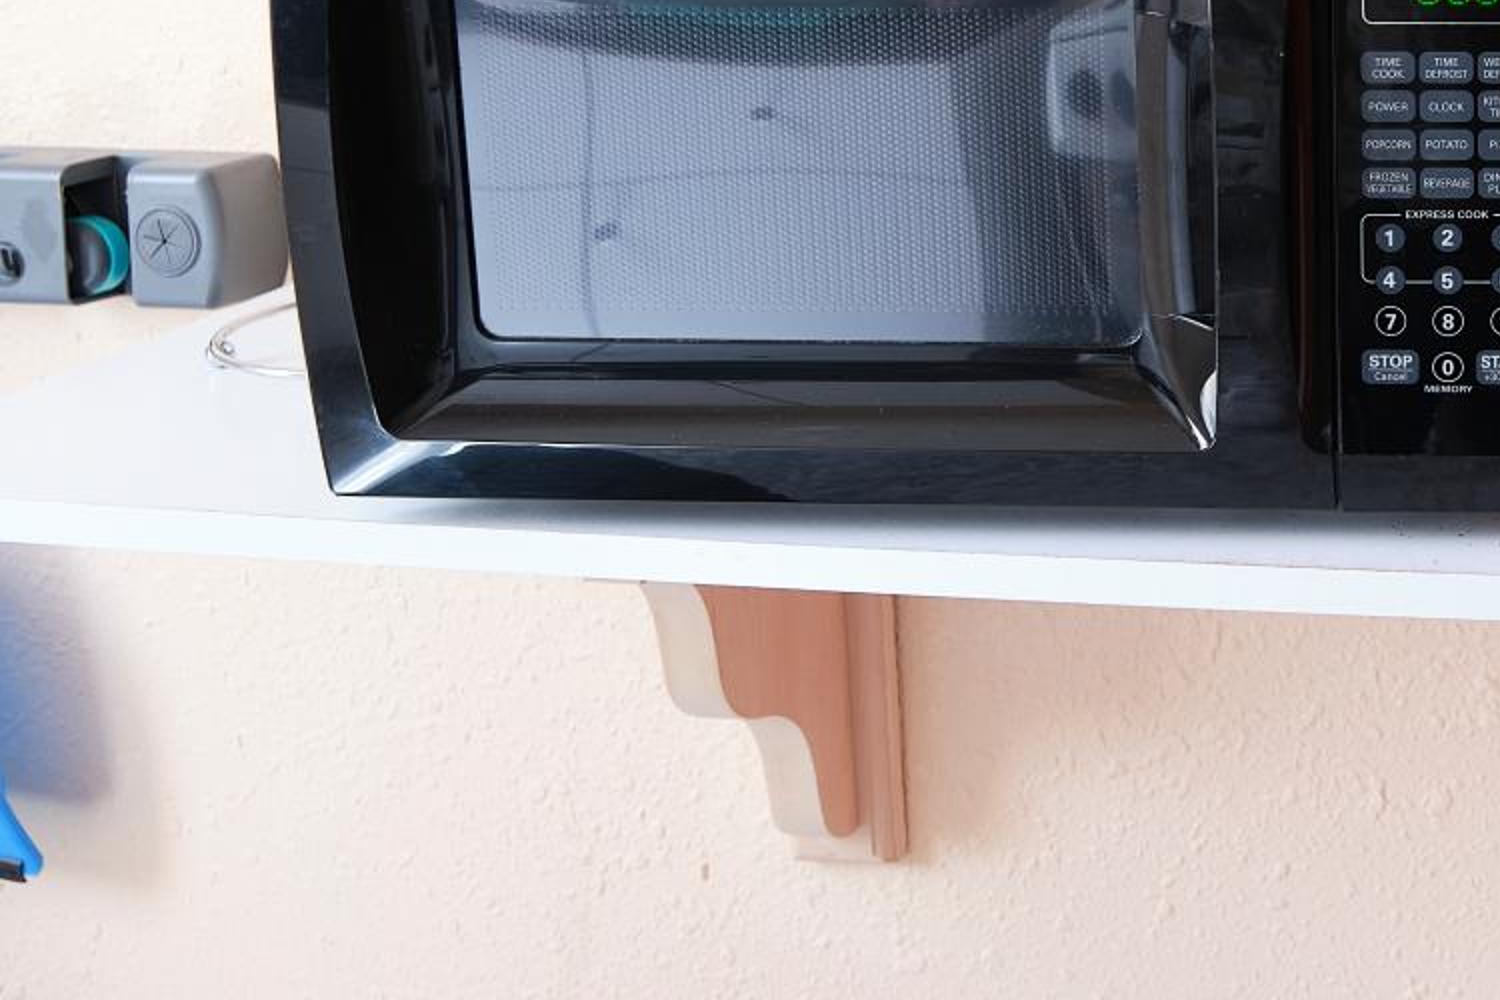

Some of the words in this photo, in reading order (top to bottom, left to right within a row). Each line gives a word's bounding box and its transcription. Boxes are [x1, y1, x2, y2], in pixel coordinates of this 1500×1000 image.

[1375, 57, 1403, 67] TIME
[1434, 57, 1459, 67] TIME
[1371, 68, 1405, 79] COOK
[1425, 68, 1468, 79] DEFROST
[1368, 101, 1409, 112] POWER
[1427, 101, 1465, 113] CLOCK
[1365, 139, 1412, 150] POPCORN
[1425, 139, 1468, 150] POTATO
[1369, 171, 1409, 183] FROZEN
[1423, 177, 1470, 189] BEVERAGE
[1405, 209, 1455, 219] EXPRESS
[1457, 209, 1489, 219] COOK
[1385, 229, 1393, 247] 1
[1441, 229, 1454, 247] 2
[1383, 271, 1396, 289] 4
[1441, 272, 1454, 290] 5
[1385, 313, 1397, 332] 7
[1442, 313, 1455, 331] 8
[1369, 354, 1414, 369] STOP
[1441, 359, 1455, 376] 0
[1374, 370, 1408, 382] Cancel
[1423, 384, 1473, 393] MEMORY
